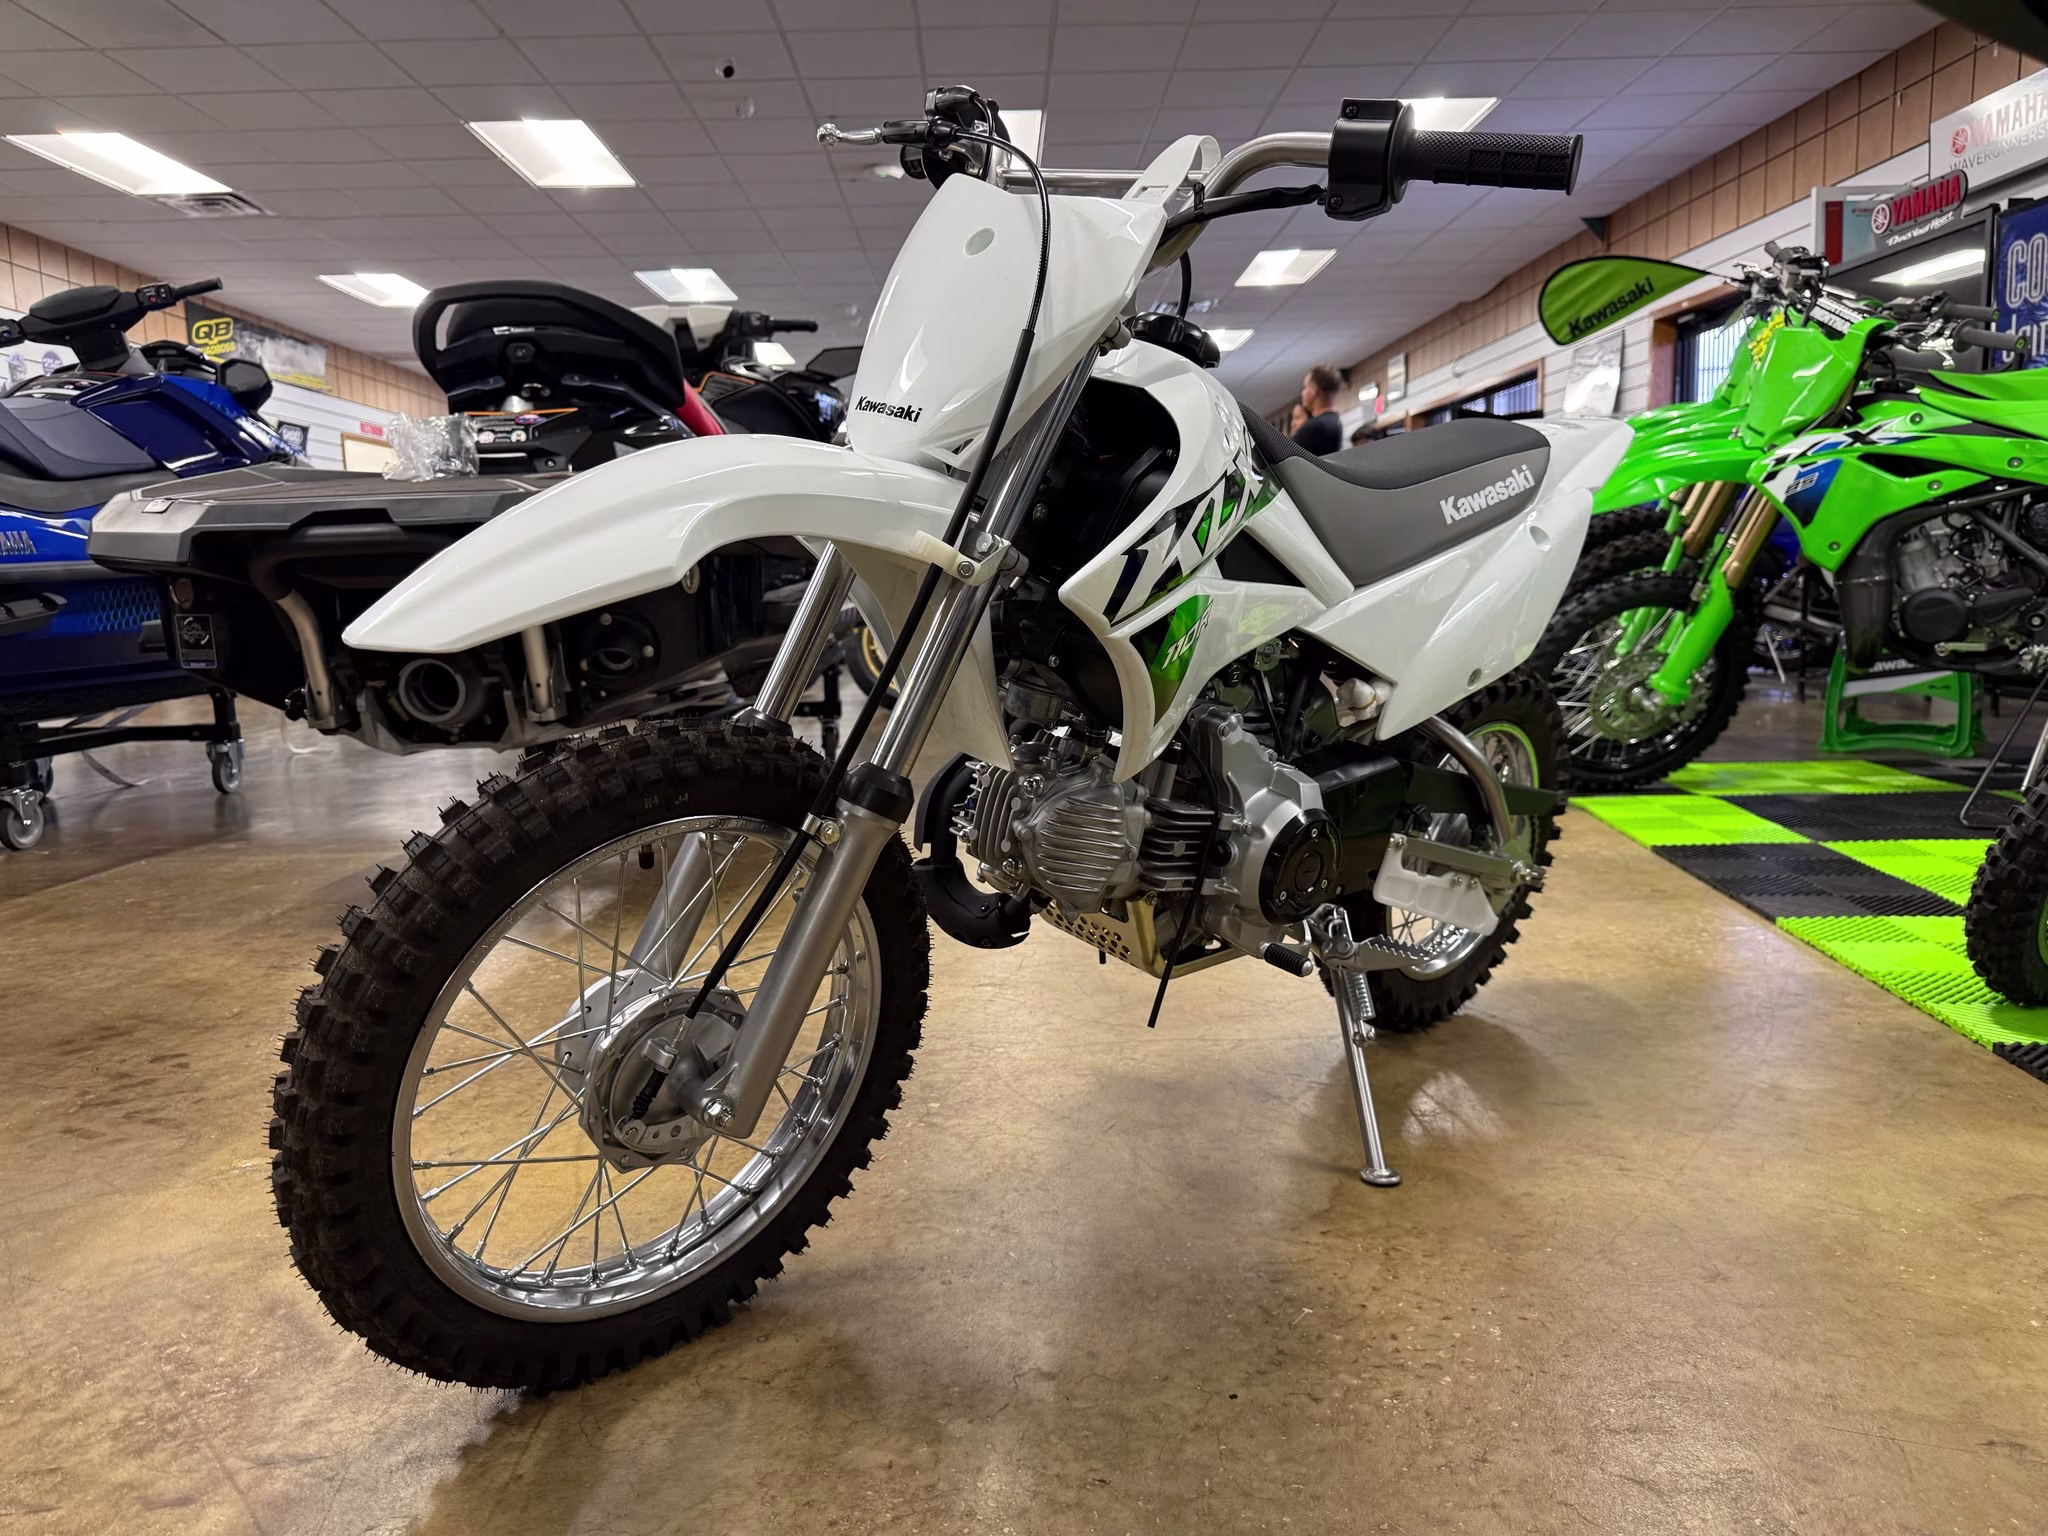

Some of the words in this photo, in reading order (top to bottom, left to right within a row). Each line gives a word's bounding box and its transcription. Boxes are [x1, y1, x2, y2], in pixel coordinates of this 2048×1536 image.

[1973, 91, 2048, 147] YAMAHA
[1891, 175, 1961, 227] YAMAHA
[194, 319, 232, 342] QB
[1567, 277, 1655, 339] Kawasaki
[855, 396, 922, 423] Kawasaki
[1439, 464, 1535, 525] Kawasaki
